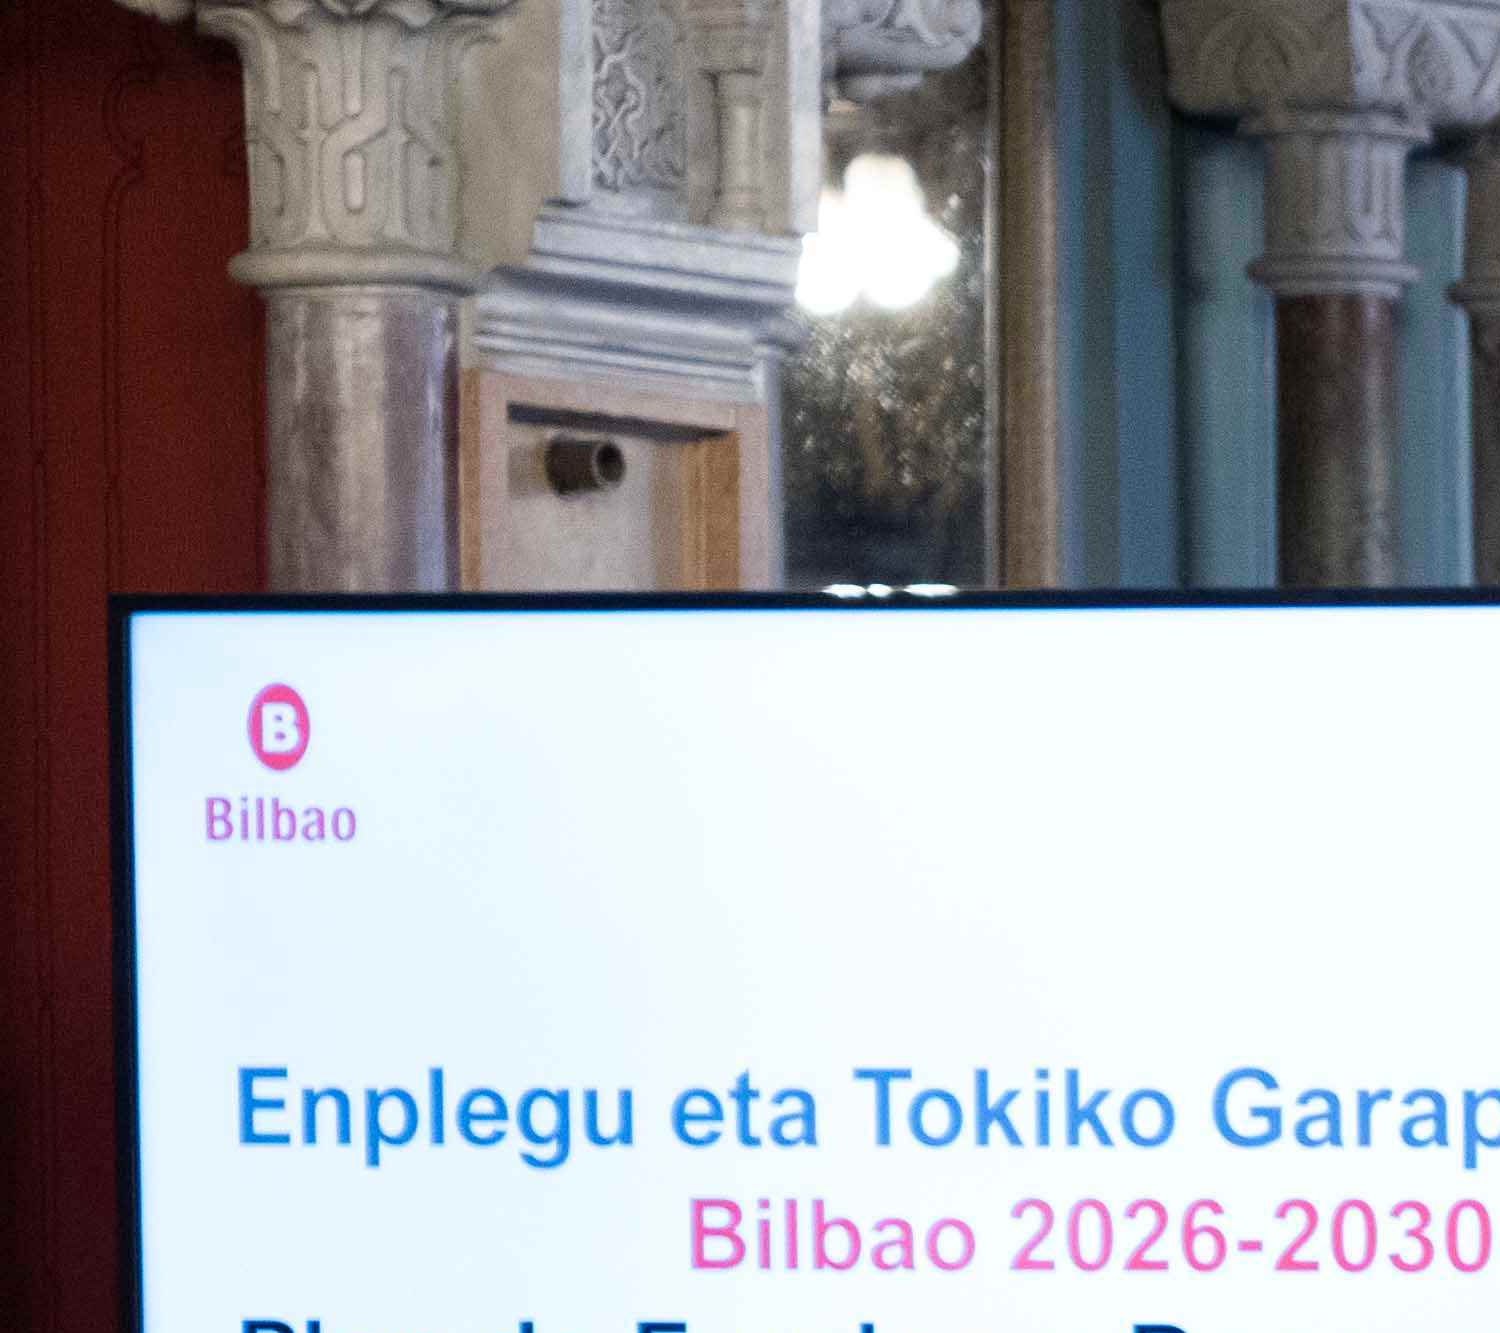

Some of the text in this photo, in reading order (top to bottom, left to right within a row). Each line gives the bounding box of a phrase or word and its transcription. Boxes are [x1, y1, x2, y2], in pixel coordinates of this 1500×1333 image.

[260, 701, 300, 753] B
[205, 796, 358, 842] Bilbao
[238, 1066, 636, 1173] Enplegu
[671, 1071, 820, 1151] eta
[853, 1067, 1177, 1150] Tokiko
[691, 1198, 1493, 1275] Bilbao 2026-2030
